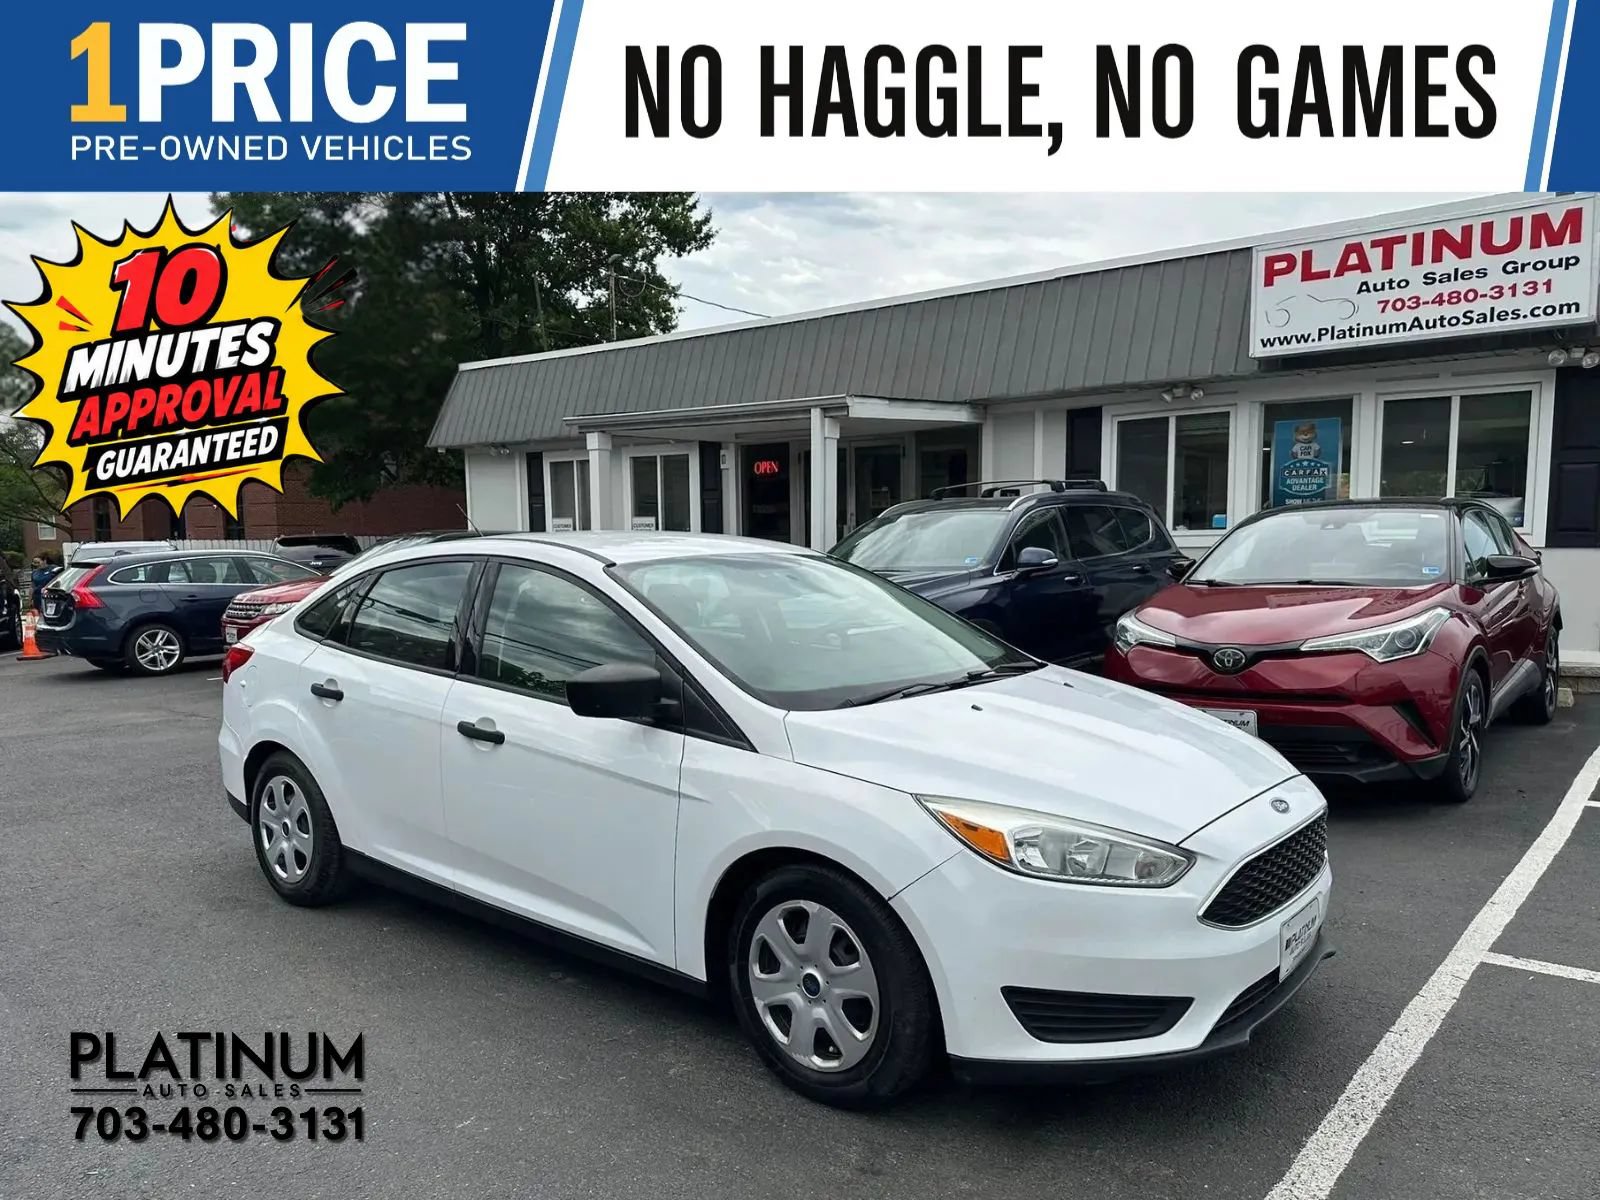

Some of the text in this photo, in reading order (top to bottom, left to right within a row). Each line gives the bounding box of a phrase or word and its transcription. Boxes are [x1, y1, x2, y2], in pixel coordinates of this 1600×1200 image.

[1264, 207, 1583, 287] PLATINUM
[1356, 255, 1580, 295] Auto Sales Group
[1377, 279, 1553, 313] 703-480-3131
[1260, 300, 1581, 348] www.PlatinumAutoSales.com
[754, 461, 779, 474] OPEN
[1284, 468, 1328, 476] CARFAX
